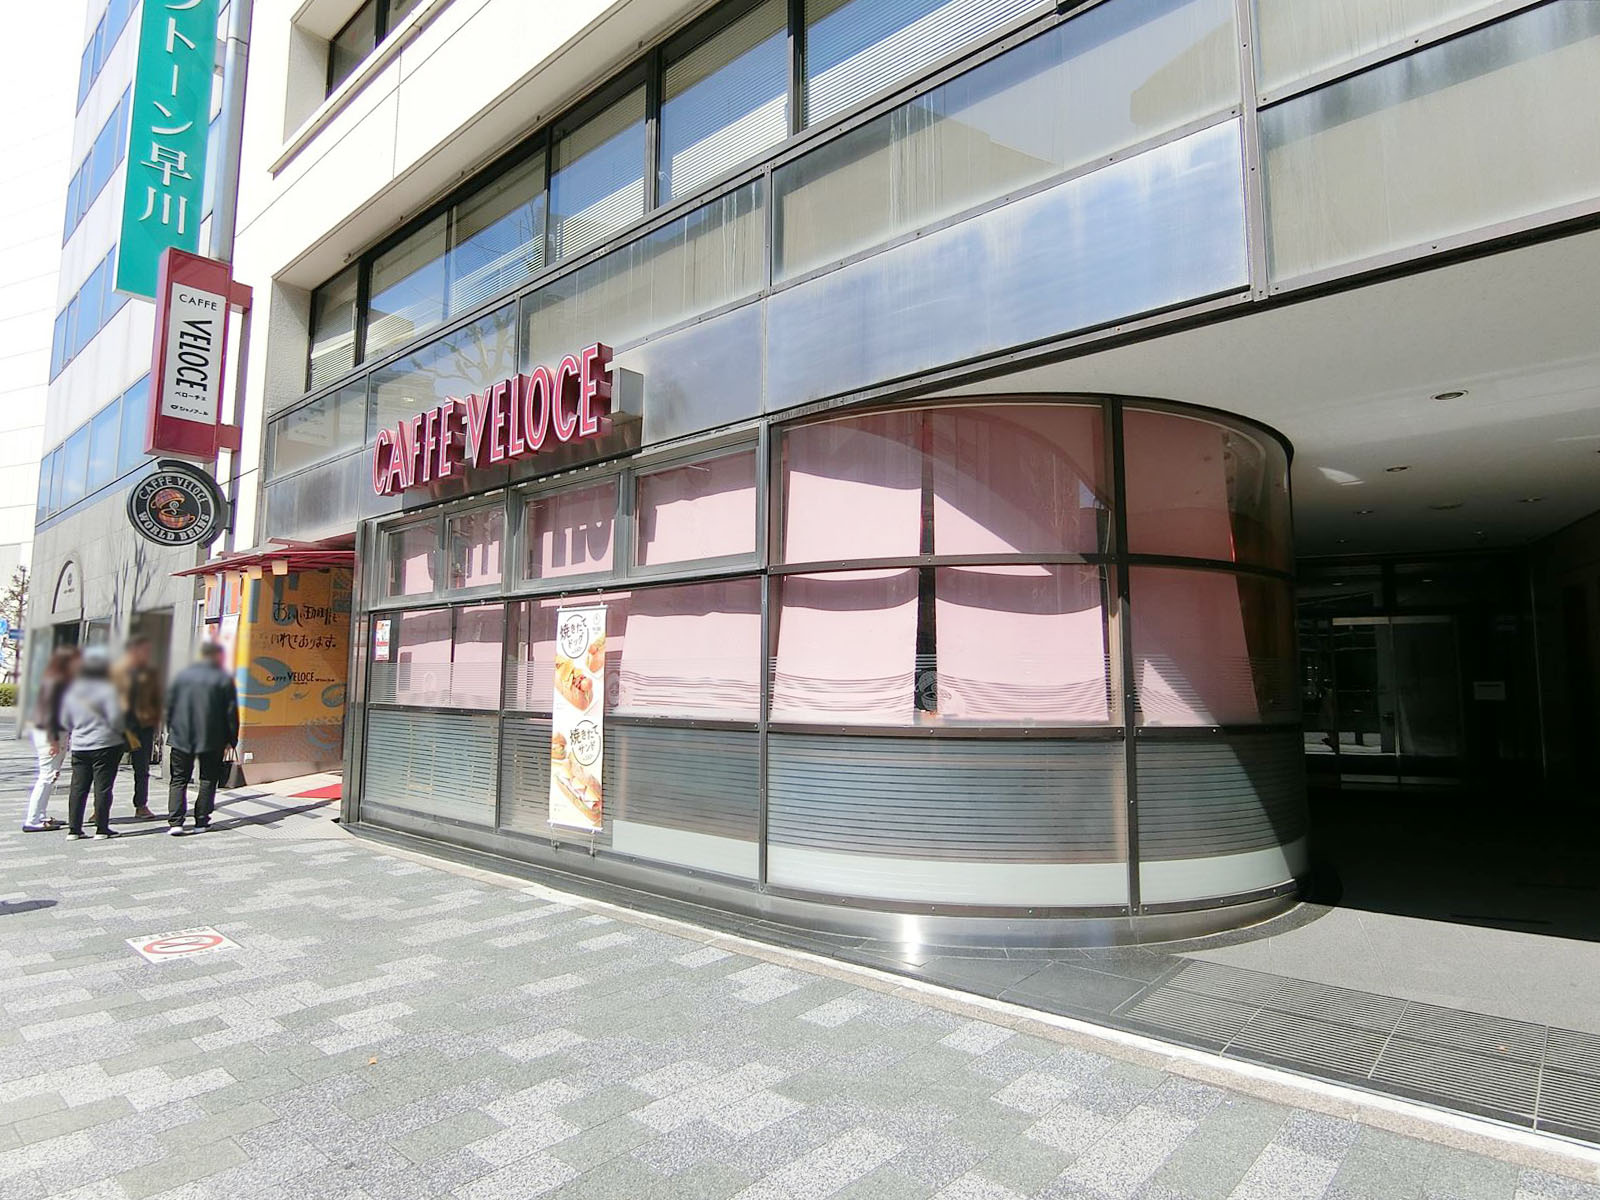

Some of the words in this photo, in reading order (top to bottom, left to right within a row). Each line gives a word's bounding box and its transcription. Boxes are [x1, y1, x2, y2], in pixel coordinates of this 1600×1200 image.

[175, 320, 213, 393] VELOCE
[465, 342, 612, 469] VELOCE
[176, 477, 209, 503] VELOCE
[138, 511, 175, 541] WORLD
[178, 513, 210, 541] BEANS
[560, 617, 587, 641] 焼きたて
[287, 671, 315, 682] VELOCE
[570, 724, 599, 746] 焼きたて
